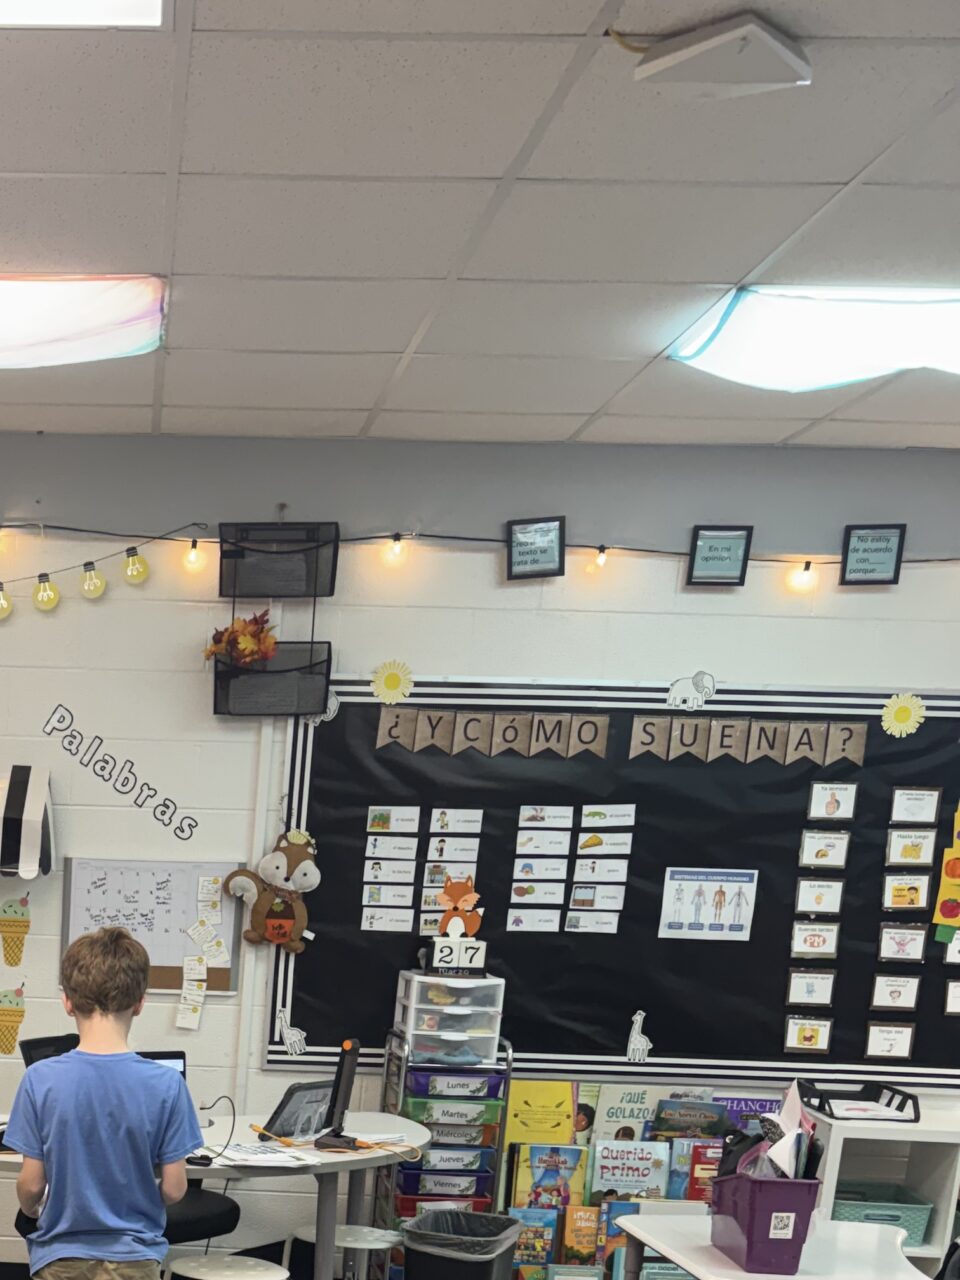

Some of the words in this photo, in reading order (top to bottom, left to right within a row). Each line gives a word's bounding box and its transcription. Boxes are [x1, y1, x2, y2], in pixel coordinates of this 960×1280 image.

[857, 536, 869, 544] No
[870, 536, 892, 545] estoy
[709, 545, 719, 553] En
[720, 545, 731, 553] mi
[850, 546, 860, 554] de
[862, 546, 893, 554] acuerdo
[640, 722, 854, 753] SUENA?
[43, 704, 198, 840] Palabras
[806, 936, 824, 947] PM
[438, 945, 481, 964] 27
[446, 1081, 470, 1089] Lunes
[620, 1090, 647, 1104] ¡QUÉ
[441, 1110, 468, 1119] Martes
[607, 1107, 656, 1120] GOLAZO!
[436, 1130, 473, 1139] Miércoles
[601, 1147, 653, 1161] Querido
[600, 1163, 651, 1179] primo
[433, 1180, 461, 1188] Viernes
